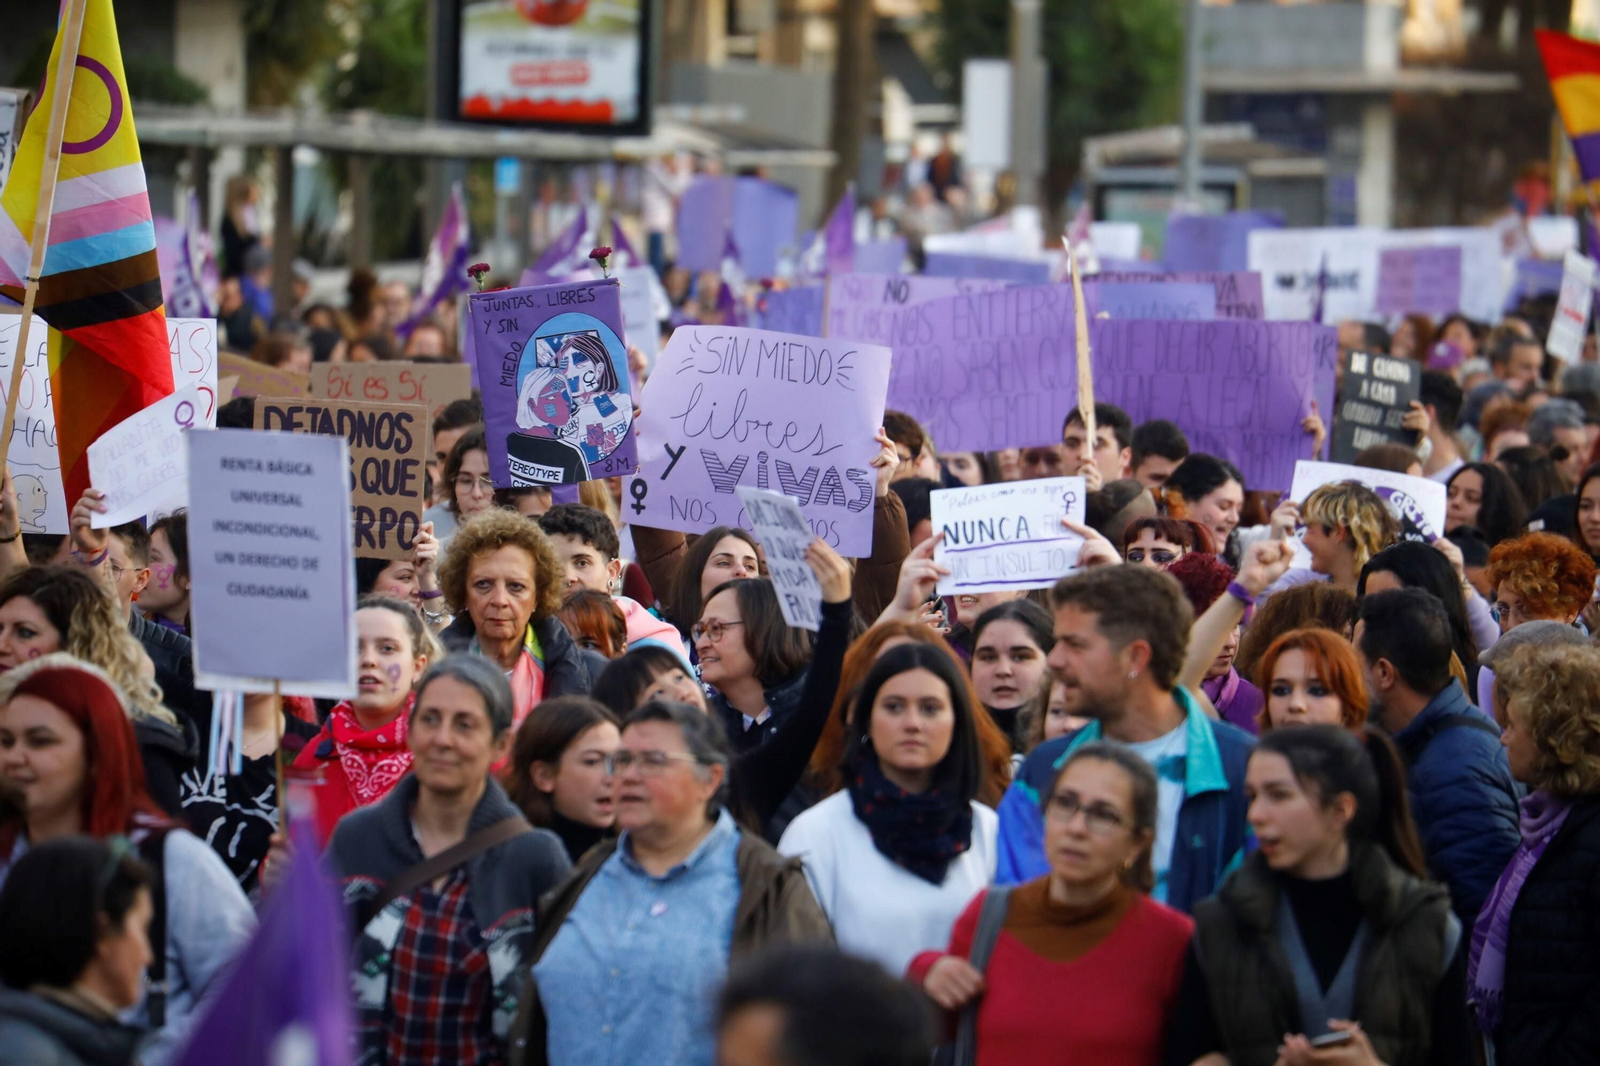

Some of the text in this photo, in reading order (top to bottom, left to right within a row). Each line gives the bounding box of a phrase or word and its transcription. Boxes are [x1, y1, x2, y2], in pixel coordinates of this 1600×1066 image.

[547, 288, 596, 307] LIBRES
[884, 278, 910, 304] NO
[483, 318, 519, 335] Y SIN
[891, 303, 934, 346] NOS
[500, 341, 522, 386] MIEDO
[1100, 321, 1312, 377] QUE DECIR ABORTO
[954, 338, 1028, 395] SABEN
[1038, 335, 1075, 391] QU
[363, 376, 388, 400] es
[670, 383, 844, 457] libres
[890, 395, 962, 451] MOS
[220, 457, 263, 474] RENTA
[361, 457, 420, 497] QUE
[231, 490, 303, 507] UNIVERSAL
[670, 495, 717, 525] NOS
[350, 505, 420, 550] RPO
[943, 516, 1031, 546] NUNCA
[214, 551, 319, 571] UN DERECHO DE
[951, 548, 1066, 579] UN INSULTO
